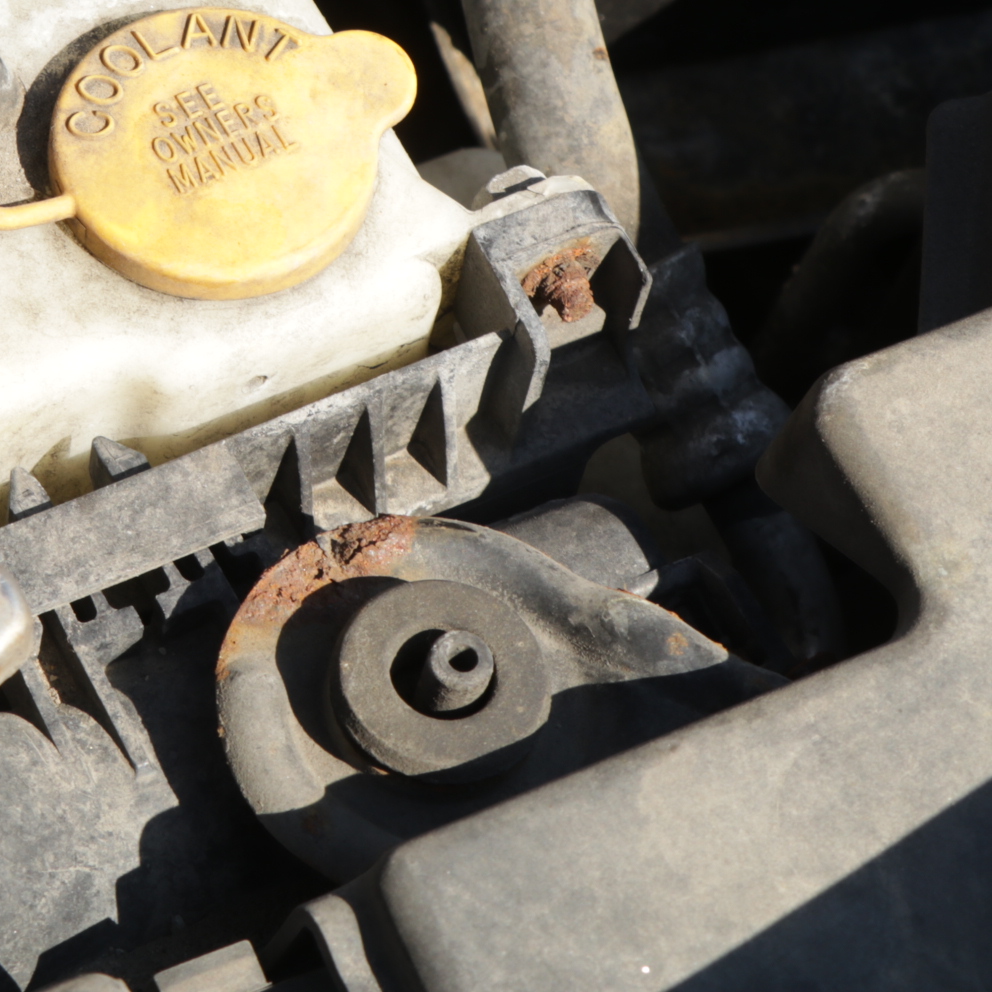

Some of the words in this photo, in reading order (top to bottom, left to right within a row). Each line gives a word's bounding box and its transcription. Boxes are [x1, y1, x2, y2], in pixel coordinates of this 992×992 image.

[66, 12, 302, 137] COOLANT
[153, 83, 224, 128] SEE
[151, 94, 279, 161] OWNERS
[166, 125, 297, 194] MANUAL
